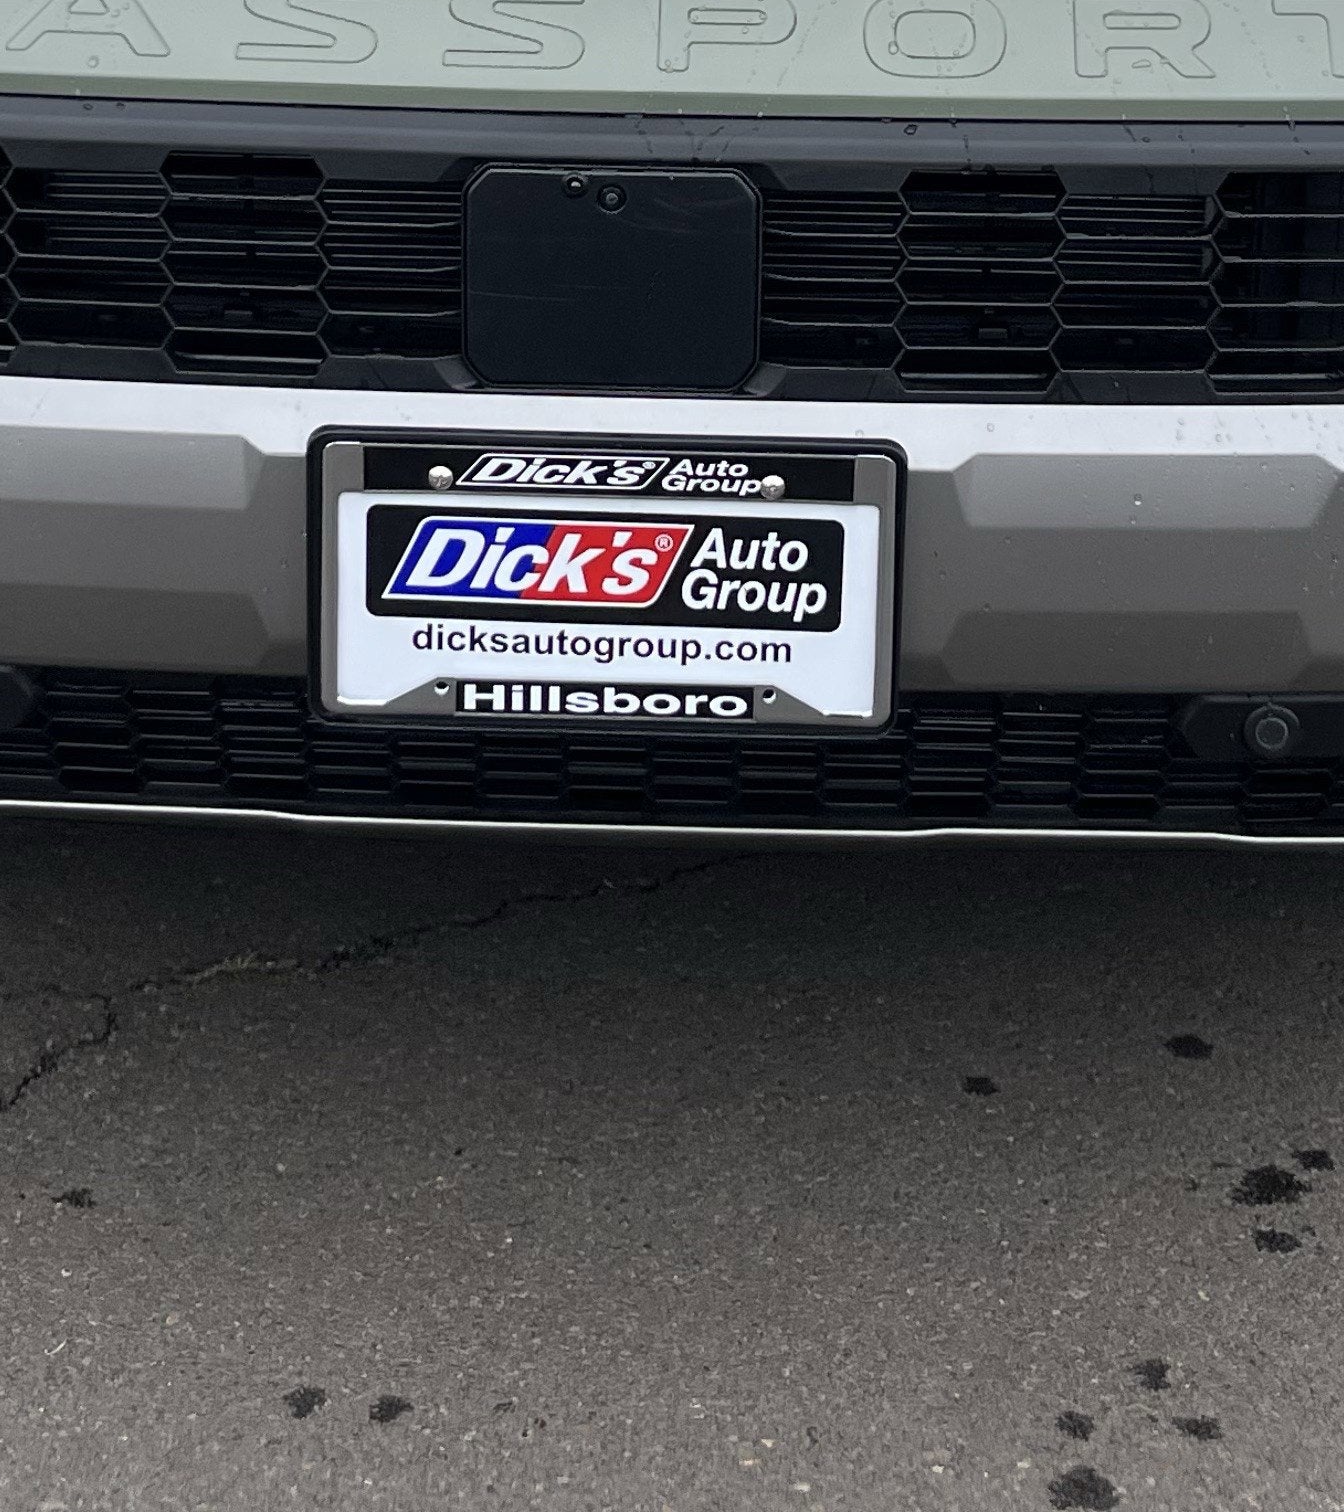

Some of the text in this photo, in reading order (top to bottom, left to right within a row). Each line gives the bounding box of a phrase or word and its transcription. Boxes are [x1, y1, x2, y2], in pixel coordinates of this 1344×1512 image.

[660, 474, 763, 496] Group
[668, 458, 750, 477] Auto
[689, 527, 809, 572] Auto
[681, 569, 828, 622] Group
[411, 623, 792, 665] dicksautogroup.com
[462, 683, 748, 717] Hillsboro
